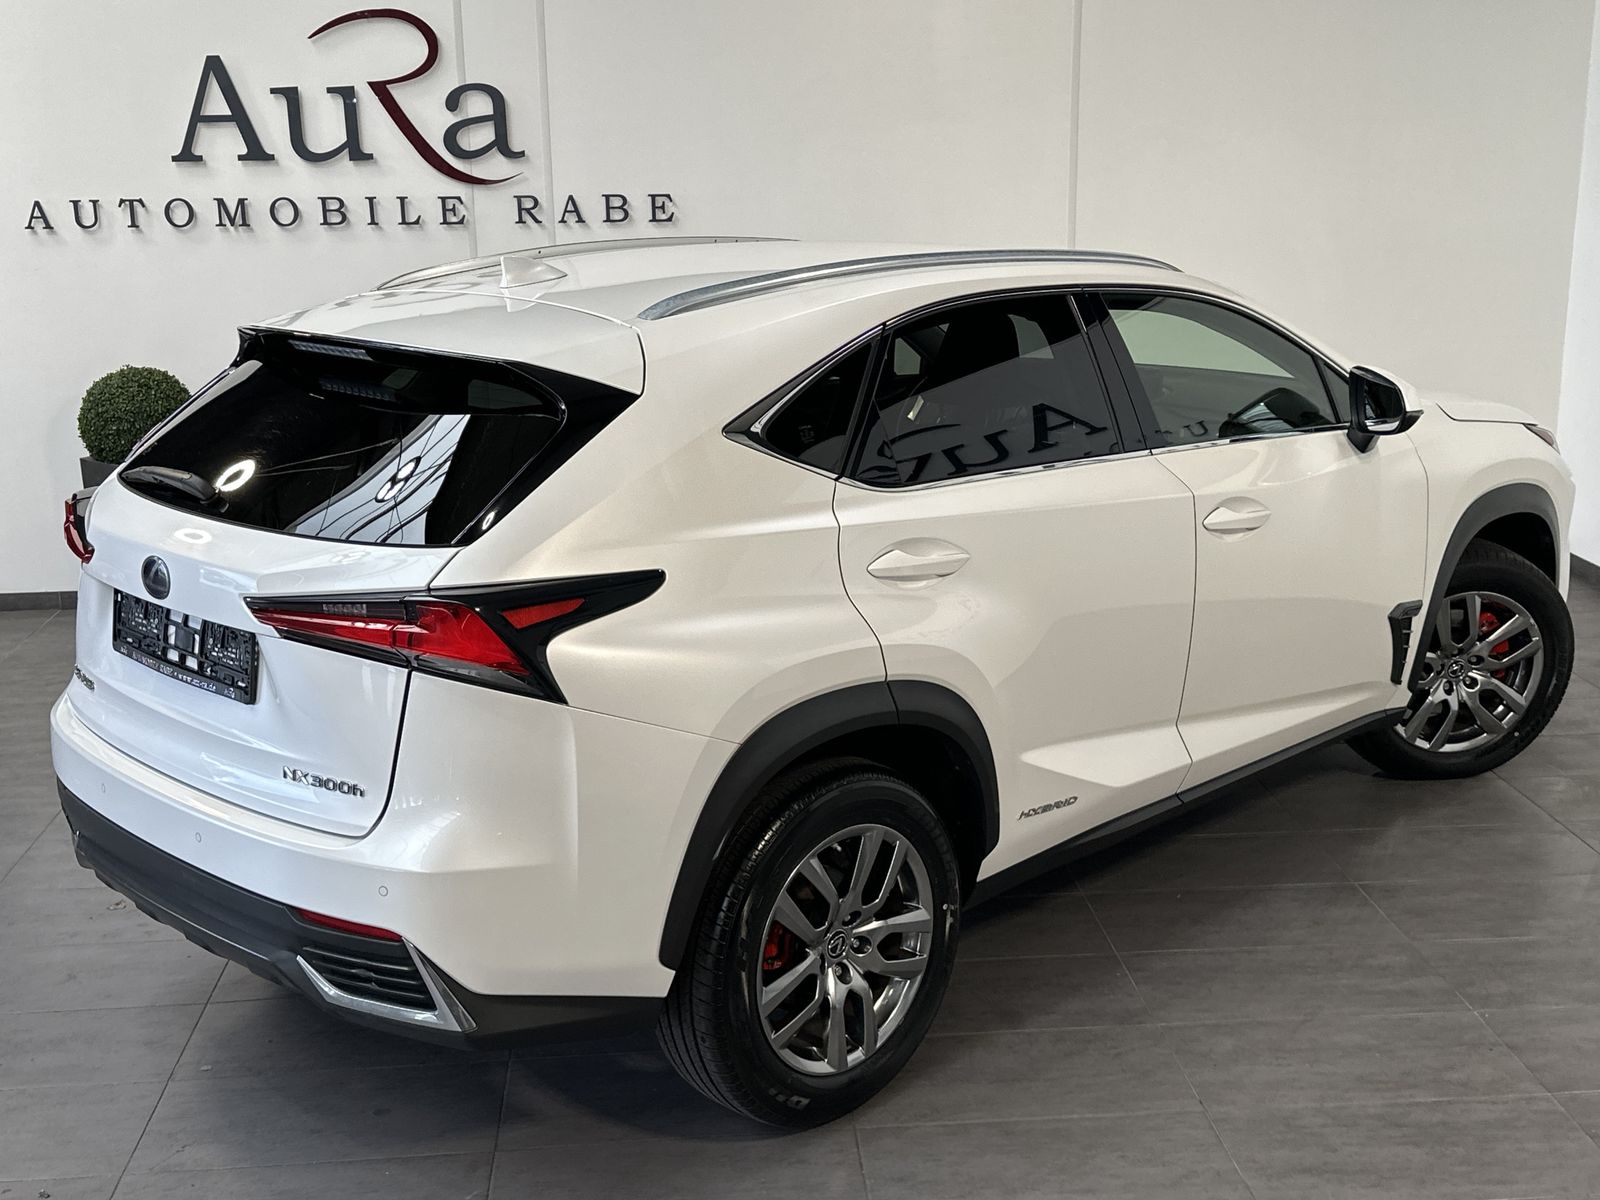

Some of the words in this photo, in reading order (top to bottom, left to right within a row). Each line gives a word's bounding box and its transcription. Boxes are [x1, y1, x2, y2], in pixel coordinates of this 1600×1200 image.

[25, 196, 466, 230] AUTOMOBILE
[514, 194, 675, 224] RABE
[282, 765, 365, 798] NX300h
[1017, 796, 1078, 821] HYBRID
